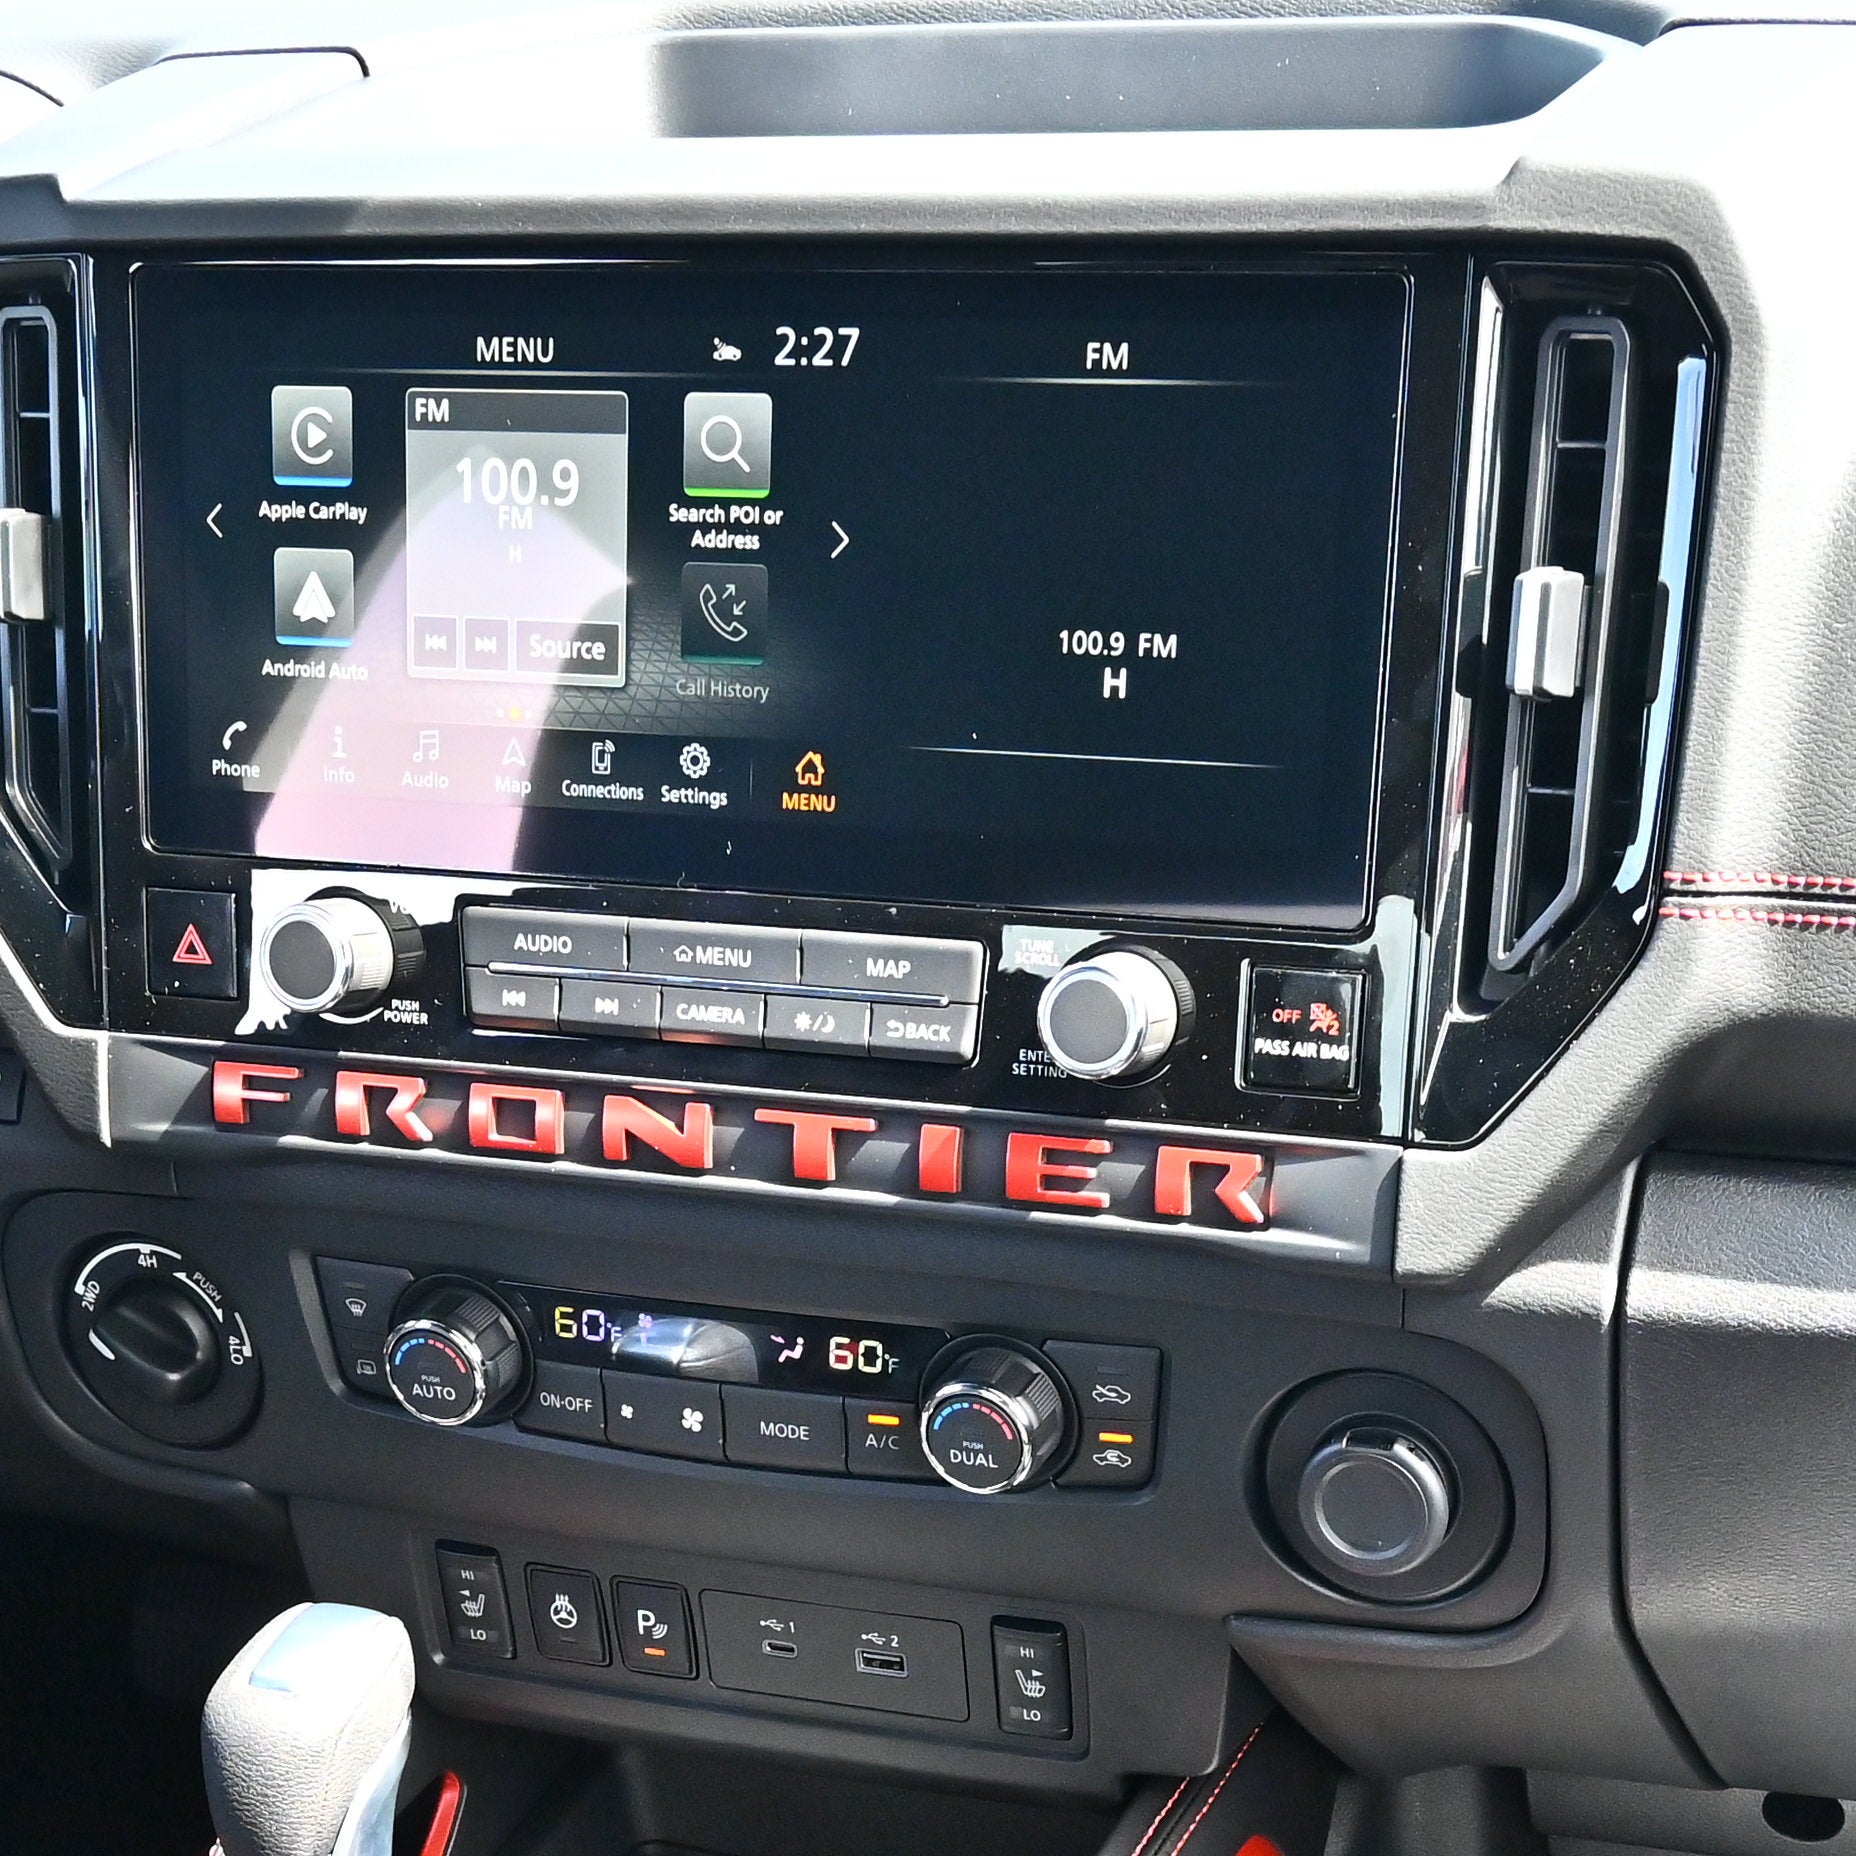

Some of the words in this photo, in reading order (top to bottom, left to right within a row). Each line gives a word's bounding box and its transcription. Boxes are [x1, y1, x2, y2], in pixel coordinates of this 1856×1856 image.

[476, 336, 555, 363] MENU
[774, 327, 860, 368] 2:27
[1085, 342, 1128, 370] FM
[415, 399, 450, 422] FM
[455, 457, 580, 507] 100.9
[259, 500, 304, 522] Apple
[308, 501, 367, 525] CarPlay
[498, 506, 533, 531] FM
[669, 504, 728, 525] Search
[732, 505, 762, 526] POI
[764, 508, 783, 526] or
[691, 529, 760, 551] Address
[529, 635, 606, 662] Source
[1058, 630, 1124, 658] 100.9
[1138, 633, 1176, 659] FM
[262, 658, 325, 679] Android
[329, 661, 368, 681] Auto
[675, 679, 708, 699] Call
[713, 680, 769, 702] History
[1103, 668, 1126, 698] H
[212, 759, 260, 781] Phone
[323, 765, 355, 785] Info
[401, 769, 449, 791] Audio
[495, 775, 532, 799] Map
[562, 779, 644, 801] Connections
[661, 784, 728, 809] Settings
[782, 791, 836, 812] MENU
[513, 932, 572, 955] AUDIO
[695, 946, 752, 967] MENU
[866, 957, 911, 979] MAP
[392, 999, 420, 1010] PUSH
[676, 1002, 746, 1025] CAMERA
[384, 1010, 428, 1025] POWER
[1272, 1009, 1301, 1024] OFF
[904, 1022, 951, 1043] BACK
[1254, 1038, 1290, 1055] PASS
[1292, 1042, 1317, 1058] AIR
[1320, 1043, 1349, 1061] BAG
[1012, 1063, 1067, 1078] SETTING
[212, 1060, 1265, 1224] FRONTIER
[138, 1254, 158, 1268] 4H
[82, 1281, 100, 1312] 2WD
[192, 1272, 223, 1302] PUSH
[228, 1336, 244, 1365] 4LO
[421, 1374, 441, 1384] PUSH
[412, 1384, 456, 1401] AUTO
[760, 1421, 810, 1440] MODE
[865, 1433, 899, 1450] A/C
[962, 1440, 983, 1450] PUSH
[950, 1450, 998, 1469] DUAL
[461, 1569, 475, 1581] HI
[470, 1628, 486, 1642] LO
[1020, 1646, 1034, 1659] HI
[1022, 1708, 1041, 1722] LO
